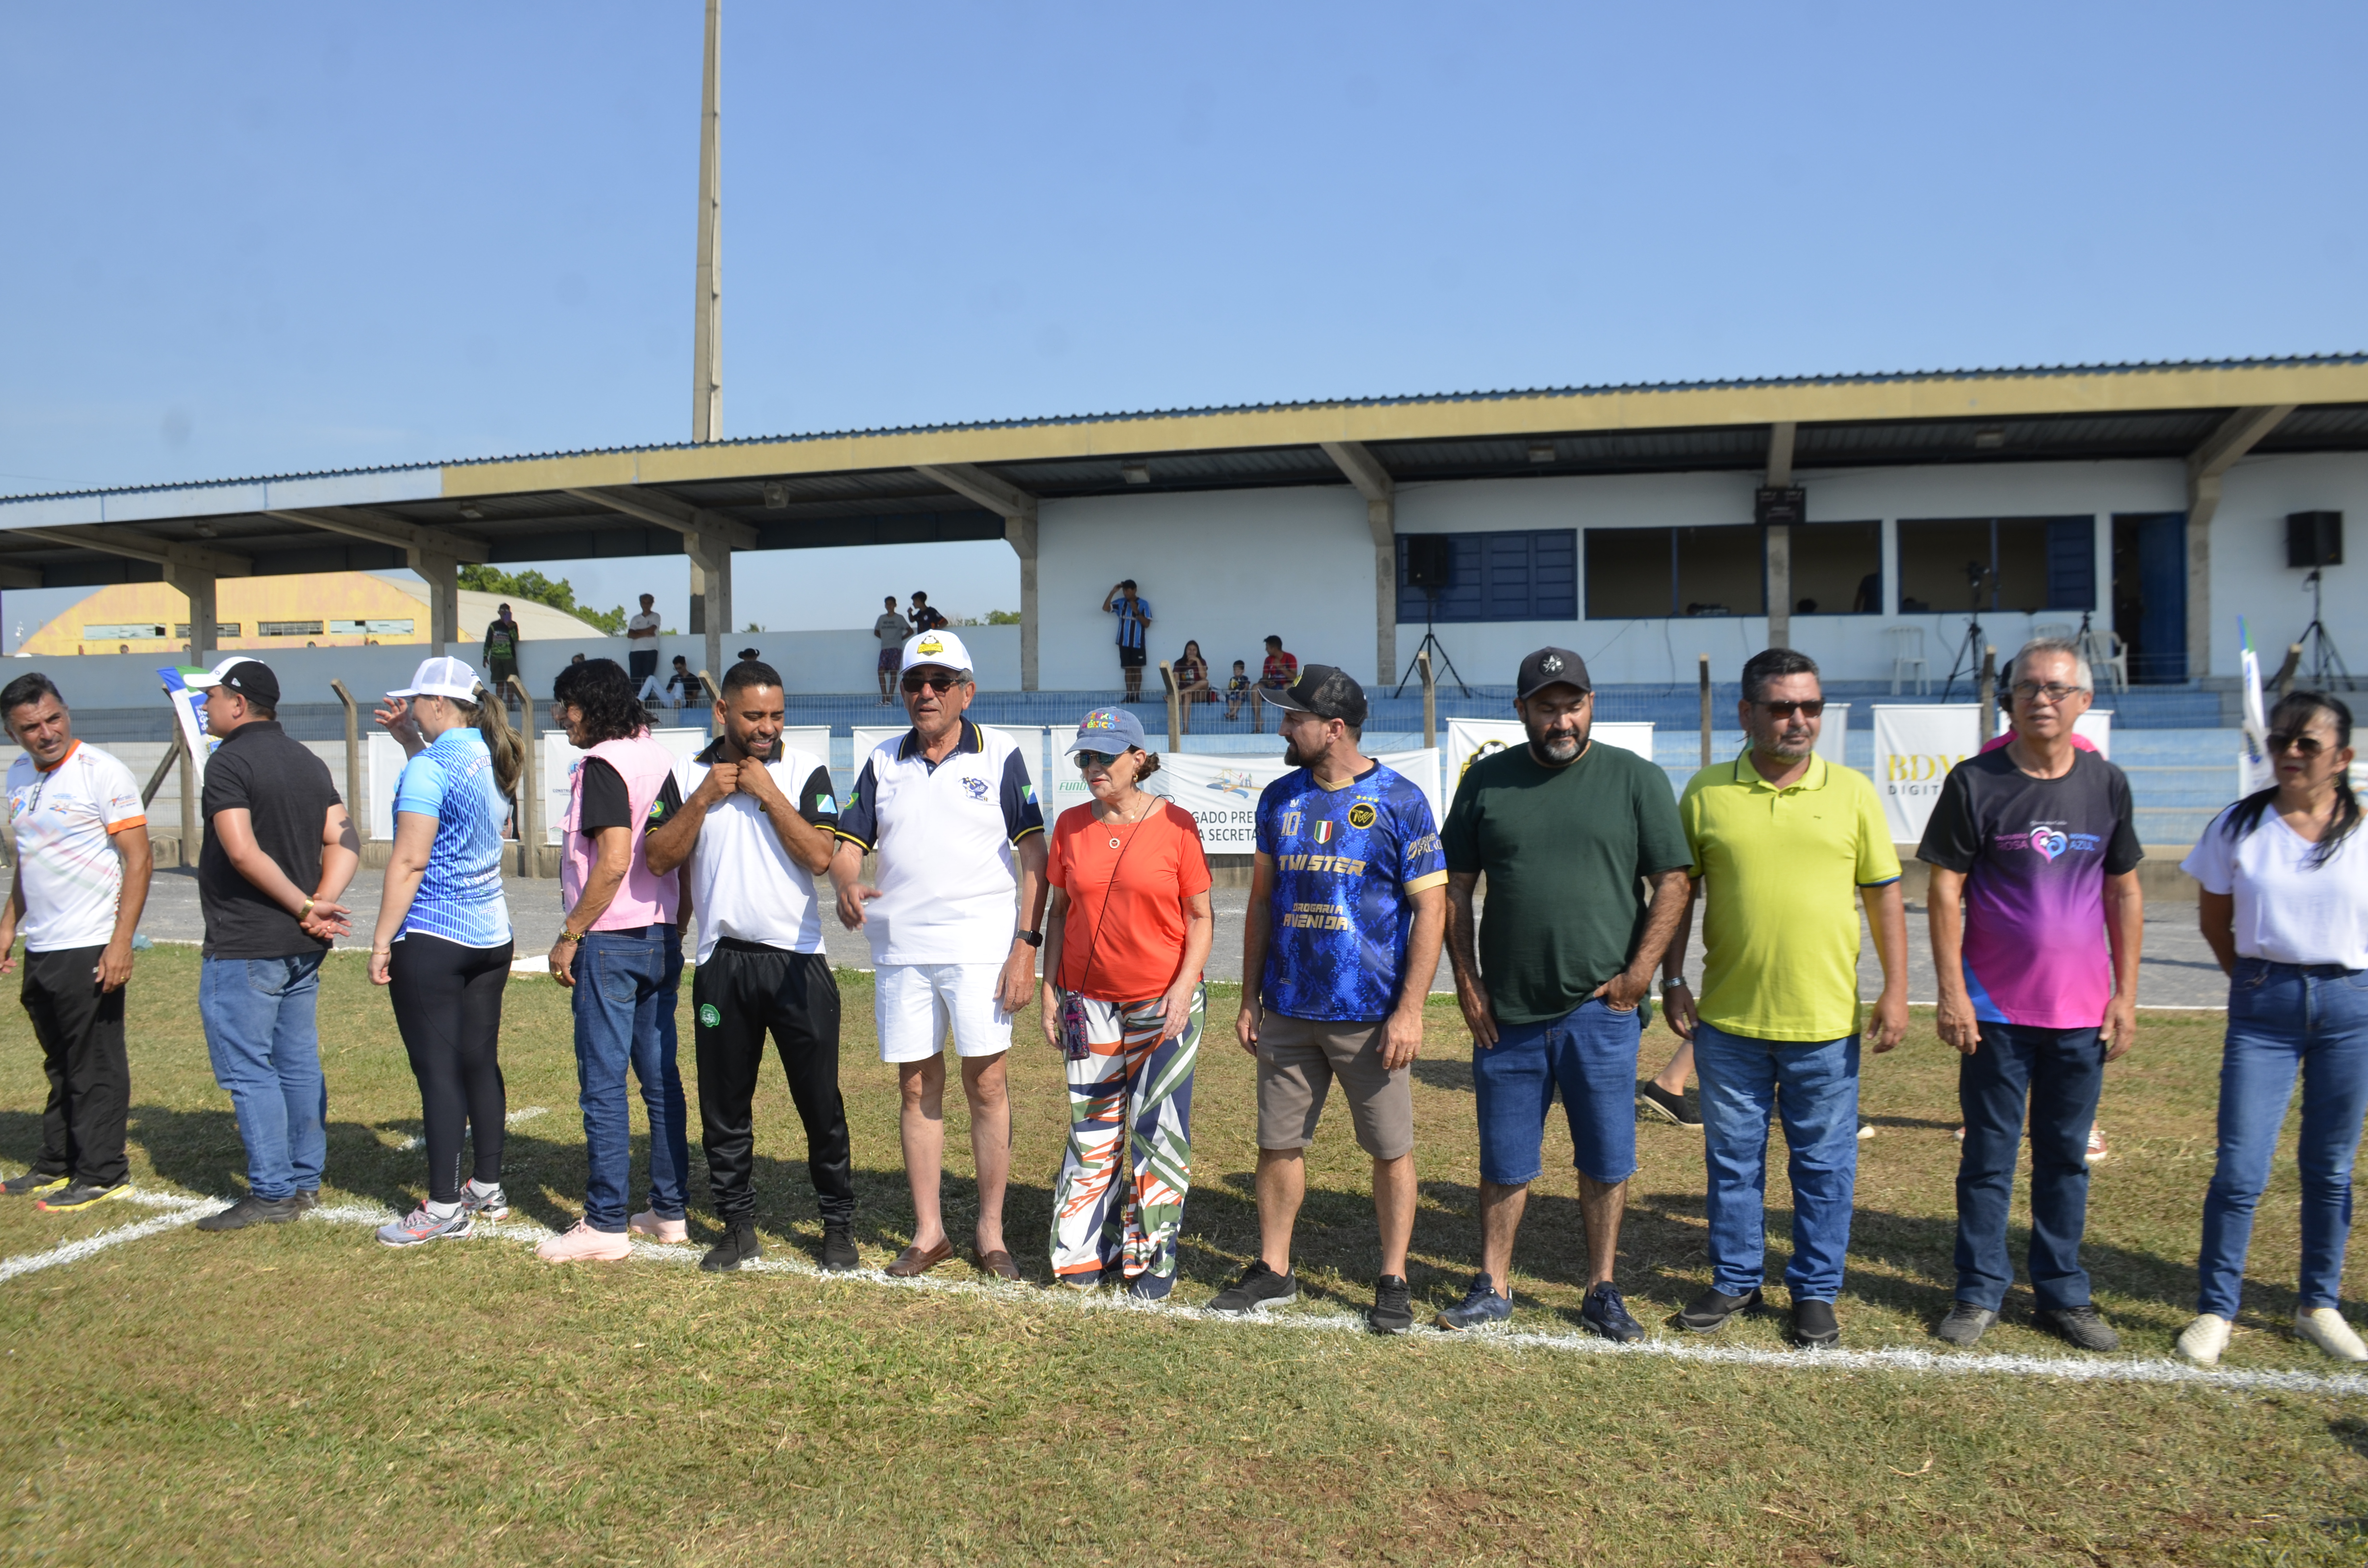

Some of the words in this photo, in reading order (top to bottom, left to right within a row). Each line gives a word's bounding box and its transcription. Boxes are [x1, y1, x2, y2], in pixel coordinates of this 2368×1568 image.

[1231, 811, 1257, 824] PRE
[1281, 811, 1301, 836] 10
[1209, 828, 1257, 841] SECRETA
[1996, 840, 2029, 851] ROSA
[2069, 840, 2095, 851] AZUL
[1278, 854, 1367, 877] TWISTER
[1293, 903, 1344, 915] DROGARIA
[1283, 913, 1348, 931] AVENIDA
